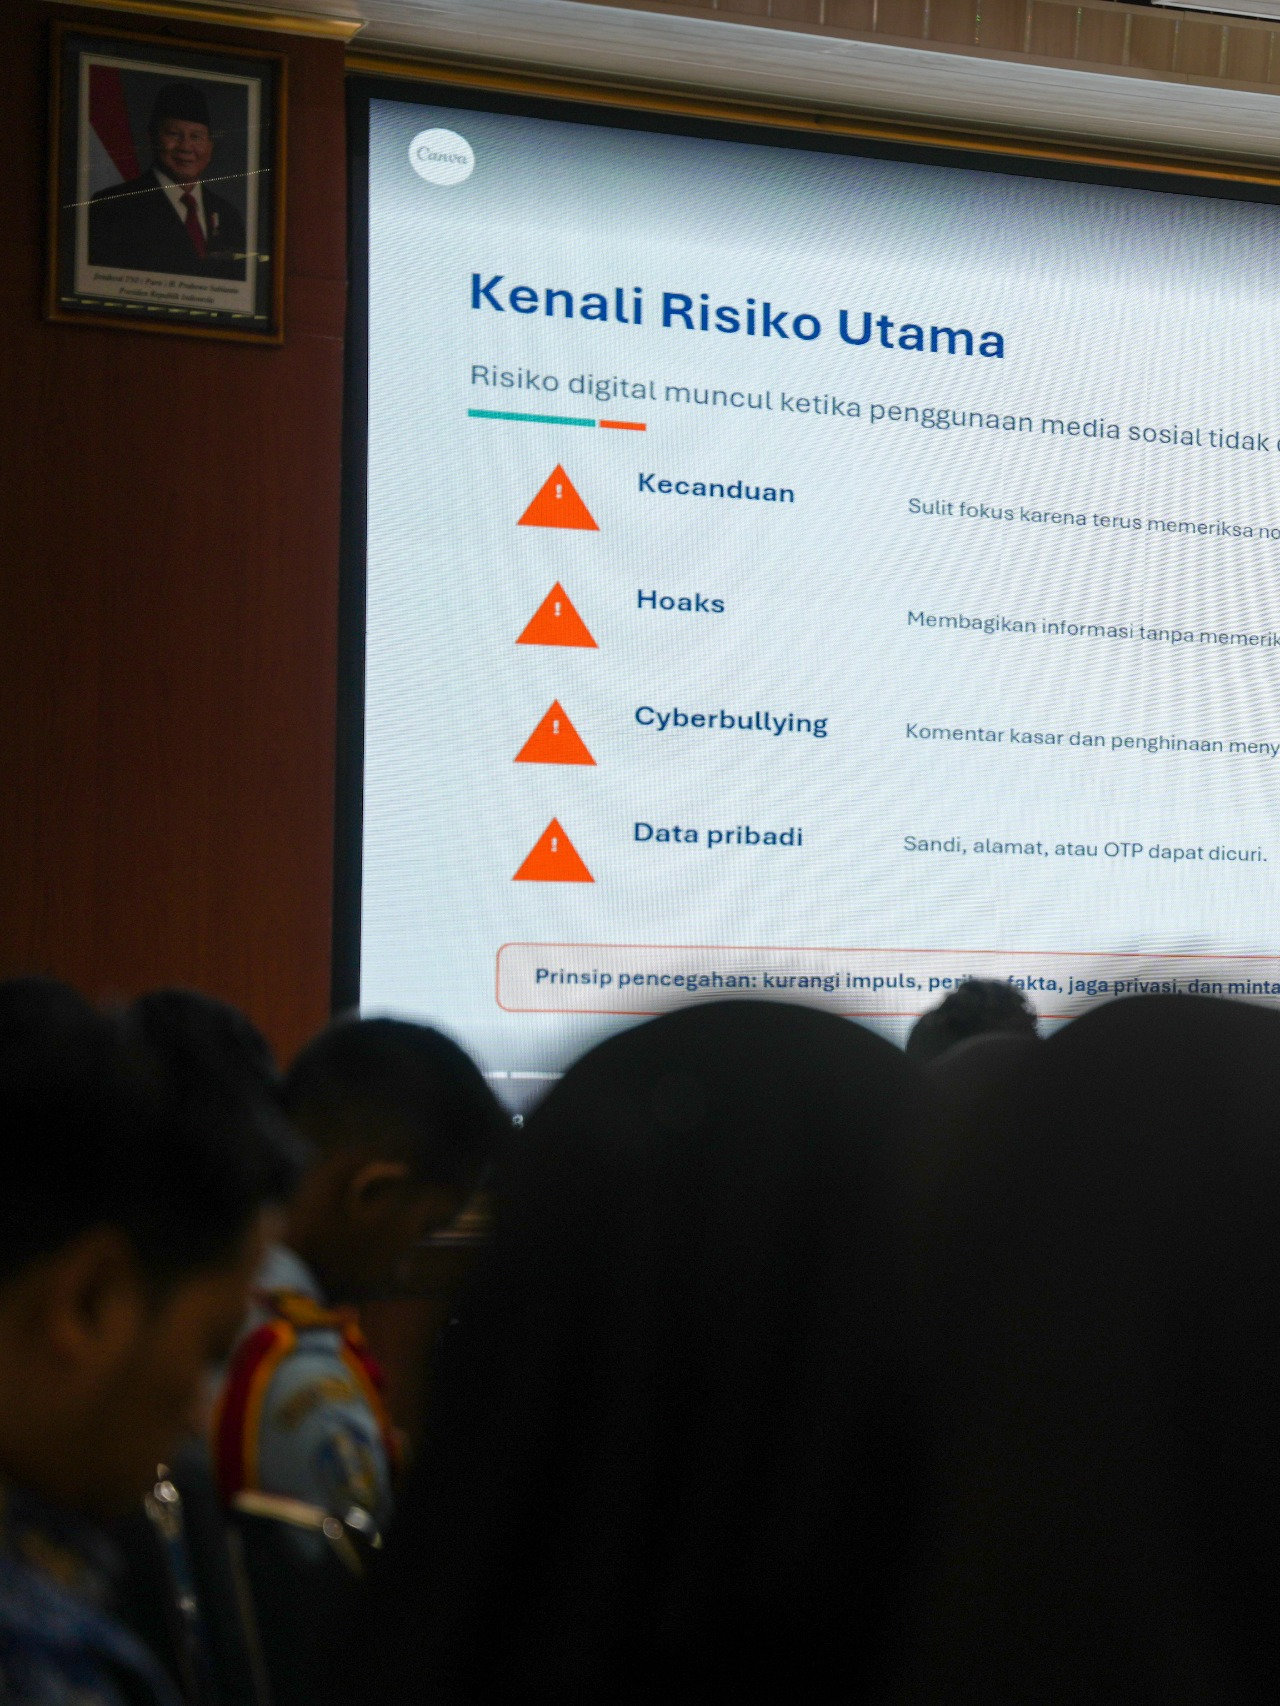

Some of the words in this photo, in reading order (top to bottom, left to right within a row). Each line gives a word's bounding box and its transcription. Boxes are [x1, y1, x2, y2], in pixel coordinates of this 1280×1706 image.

[416, 145, 468, 164] Canva
[470, 272, 643, 326] Kenali
[661, 291, 822, 342] Risiko
[838, 308, 1005, 359] Utama
[470, 364, 560, 394] Risiko
[567, 372, 657, 404] digital
[664, 379, 773, 411] muncul
[779, 390, 861, 418] ketika
[868, 402, 1033, 433] penggunaan
[1041, 415, 1121, 441] media
[1128, 423, 1203, 448] sosial
[1208, 428, 1270, 453] tidak
[638, 471, 796, 503] Kecanduan
[907, 497, 954, 517] Sulit
[959, 500, 1015, 522] fokus
[1019, 505, 1087, 527] karena
[1092, 512, 1142, 531] terus
[1147, 516, 1254, 539] memeriksa
[637, 588, 726, 614] Hoaks
[907, 610, 1037, 637] Membagikan
[1041, 617, 1134, 640] informasi
[1139, 625, 1194, 646] tanpa
[634, 705, 829, 739] Cyberbullying
[905, 722, 1004, 743] Komentar
[1009, 726, 1064, 747] kasar
[1068, 730, 1106, 748] dan
[1111, 733, 1224, 754] penghinaan
[633, 822, 698, 844] Data
[707, 825, 803, 849] pribadi
[903, 834, 968, 857] Sandi,
[972, 838, 1049, 859] alamat,
[1055, 840, 1098, 858] atau
[1103, 841, 1144, 859] OTP
[1148, 842, 1203, 864] dapat
[1208, 844, 1268, 864] dicuri.
[535, 967, 612, 988] Prinsip
[618, 970, 758, 992] pencegahan:
[762, 972, 840, 992] kurangi
[845, 972, 923, 992] impuls,
[1067, 976, 1109, 996] jaga
[1113, 977, 1184, 997] privasi,
[1188, 978, 1223, 996] dan
[1228, 979, 1280, 996] minta
